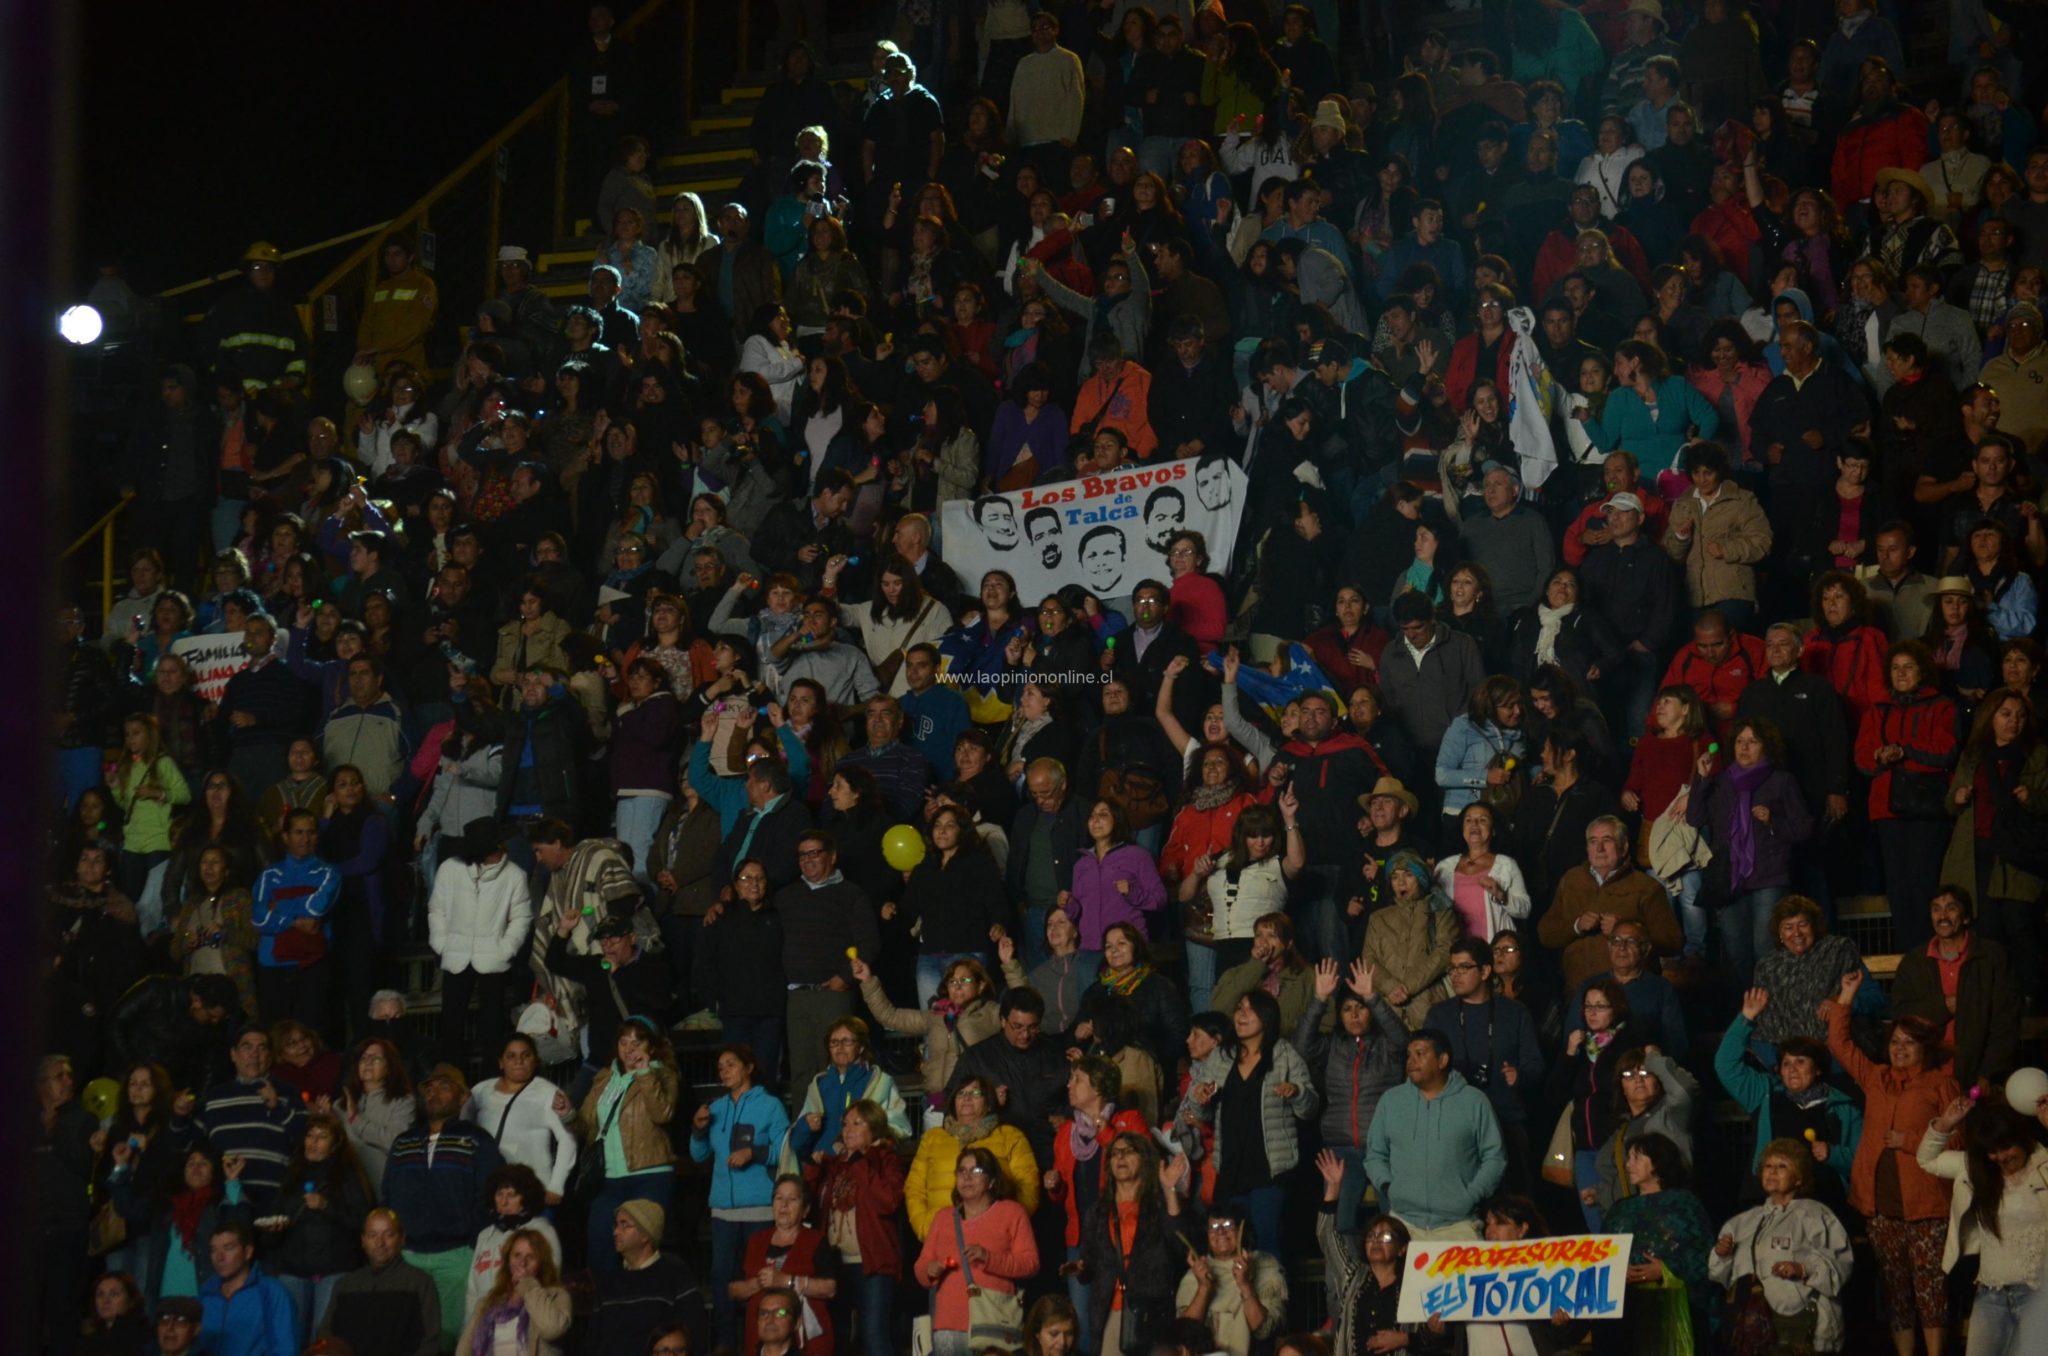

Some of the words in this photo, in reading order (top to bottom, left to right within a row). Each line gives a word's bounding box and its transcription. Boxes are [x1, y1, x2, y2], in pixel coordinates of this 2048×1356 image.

[1022, 486, 1076, 509] Los
[1082, 463, 1187, 500] Bravos
[1114, 493, 1133, 506] de
[1066, 503, 1139, 526] Talca
[916, 714, 934, 742] P
[1432, 1238, 1616, 1275] PROFESORAS
[1470, 1265, 1618, 1317] TOTORAL
